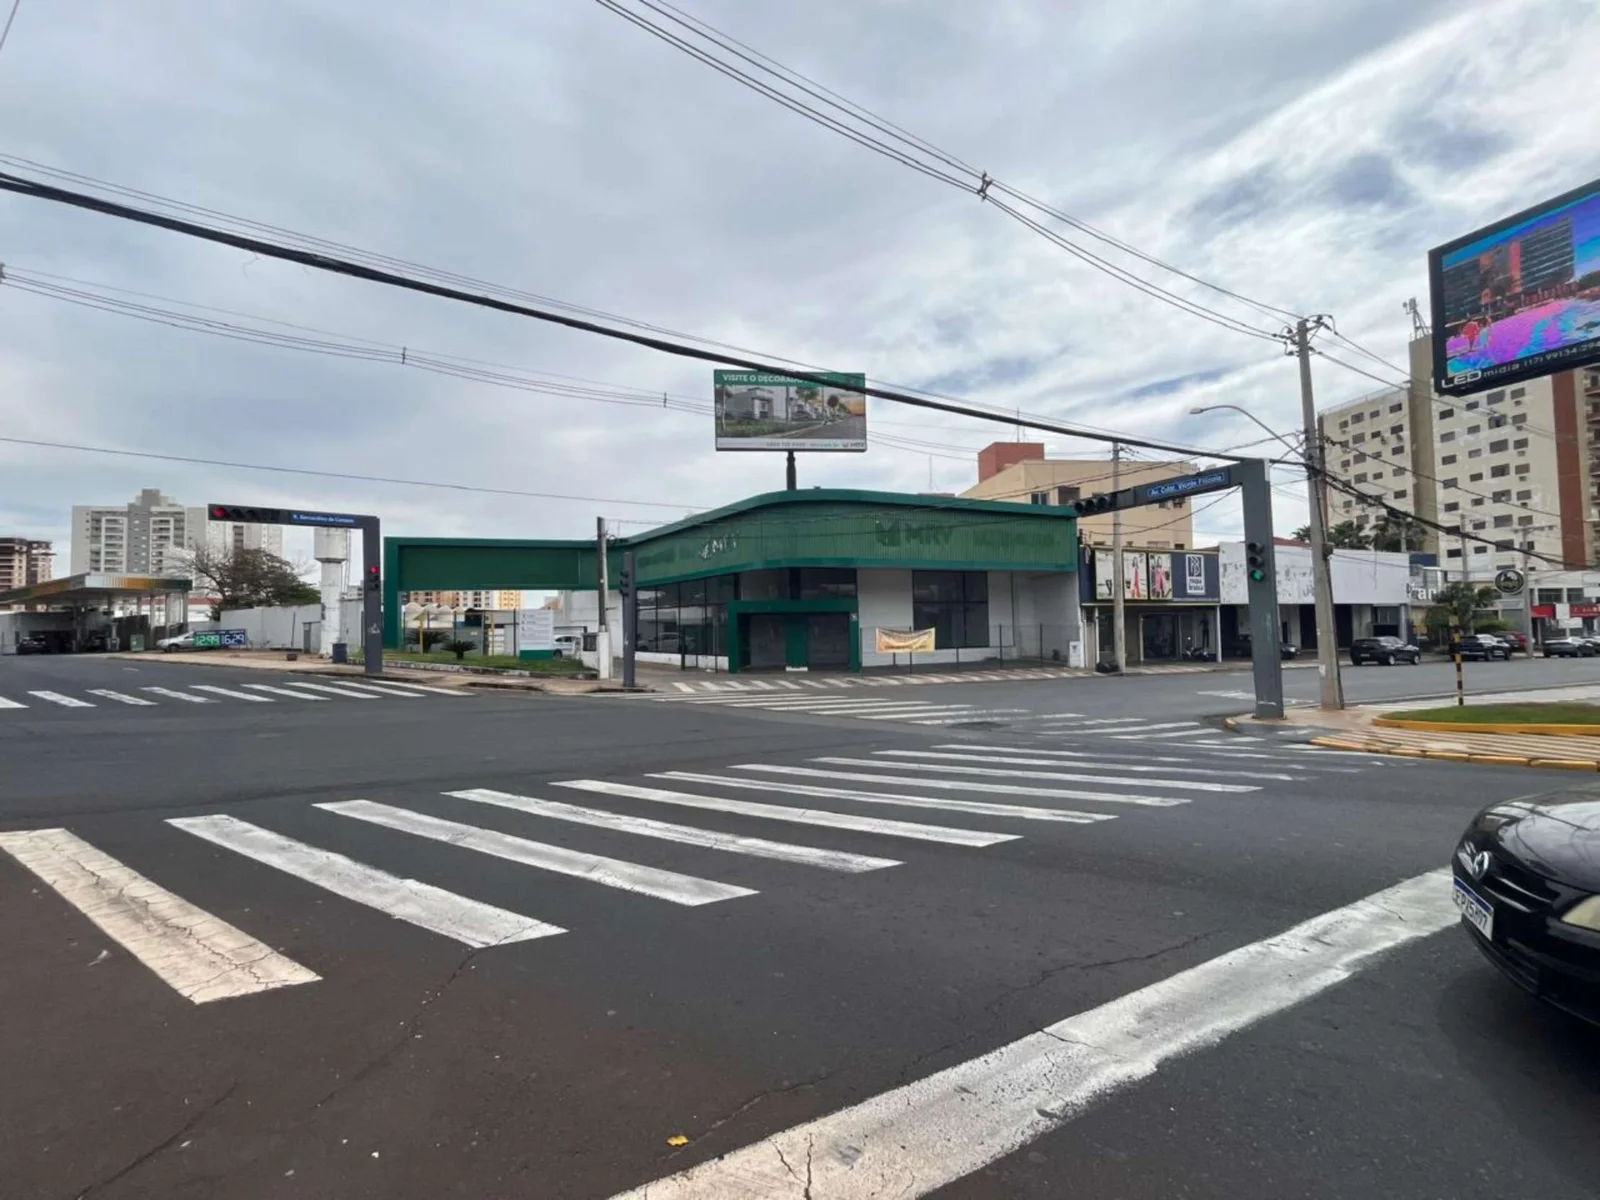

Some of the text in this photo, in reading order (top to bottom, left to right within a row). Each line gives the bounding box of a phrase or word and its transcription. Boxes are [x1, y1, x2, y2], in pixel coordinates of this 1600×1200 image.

[722, 373, 748, 381] VISITE
[749, 374, 756, 382] O
[1441, 371, 1481, 388] LED
